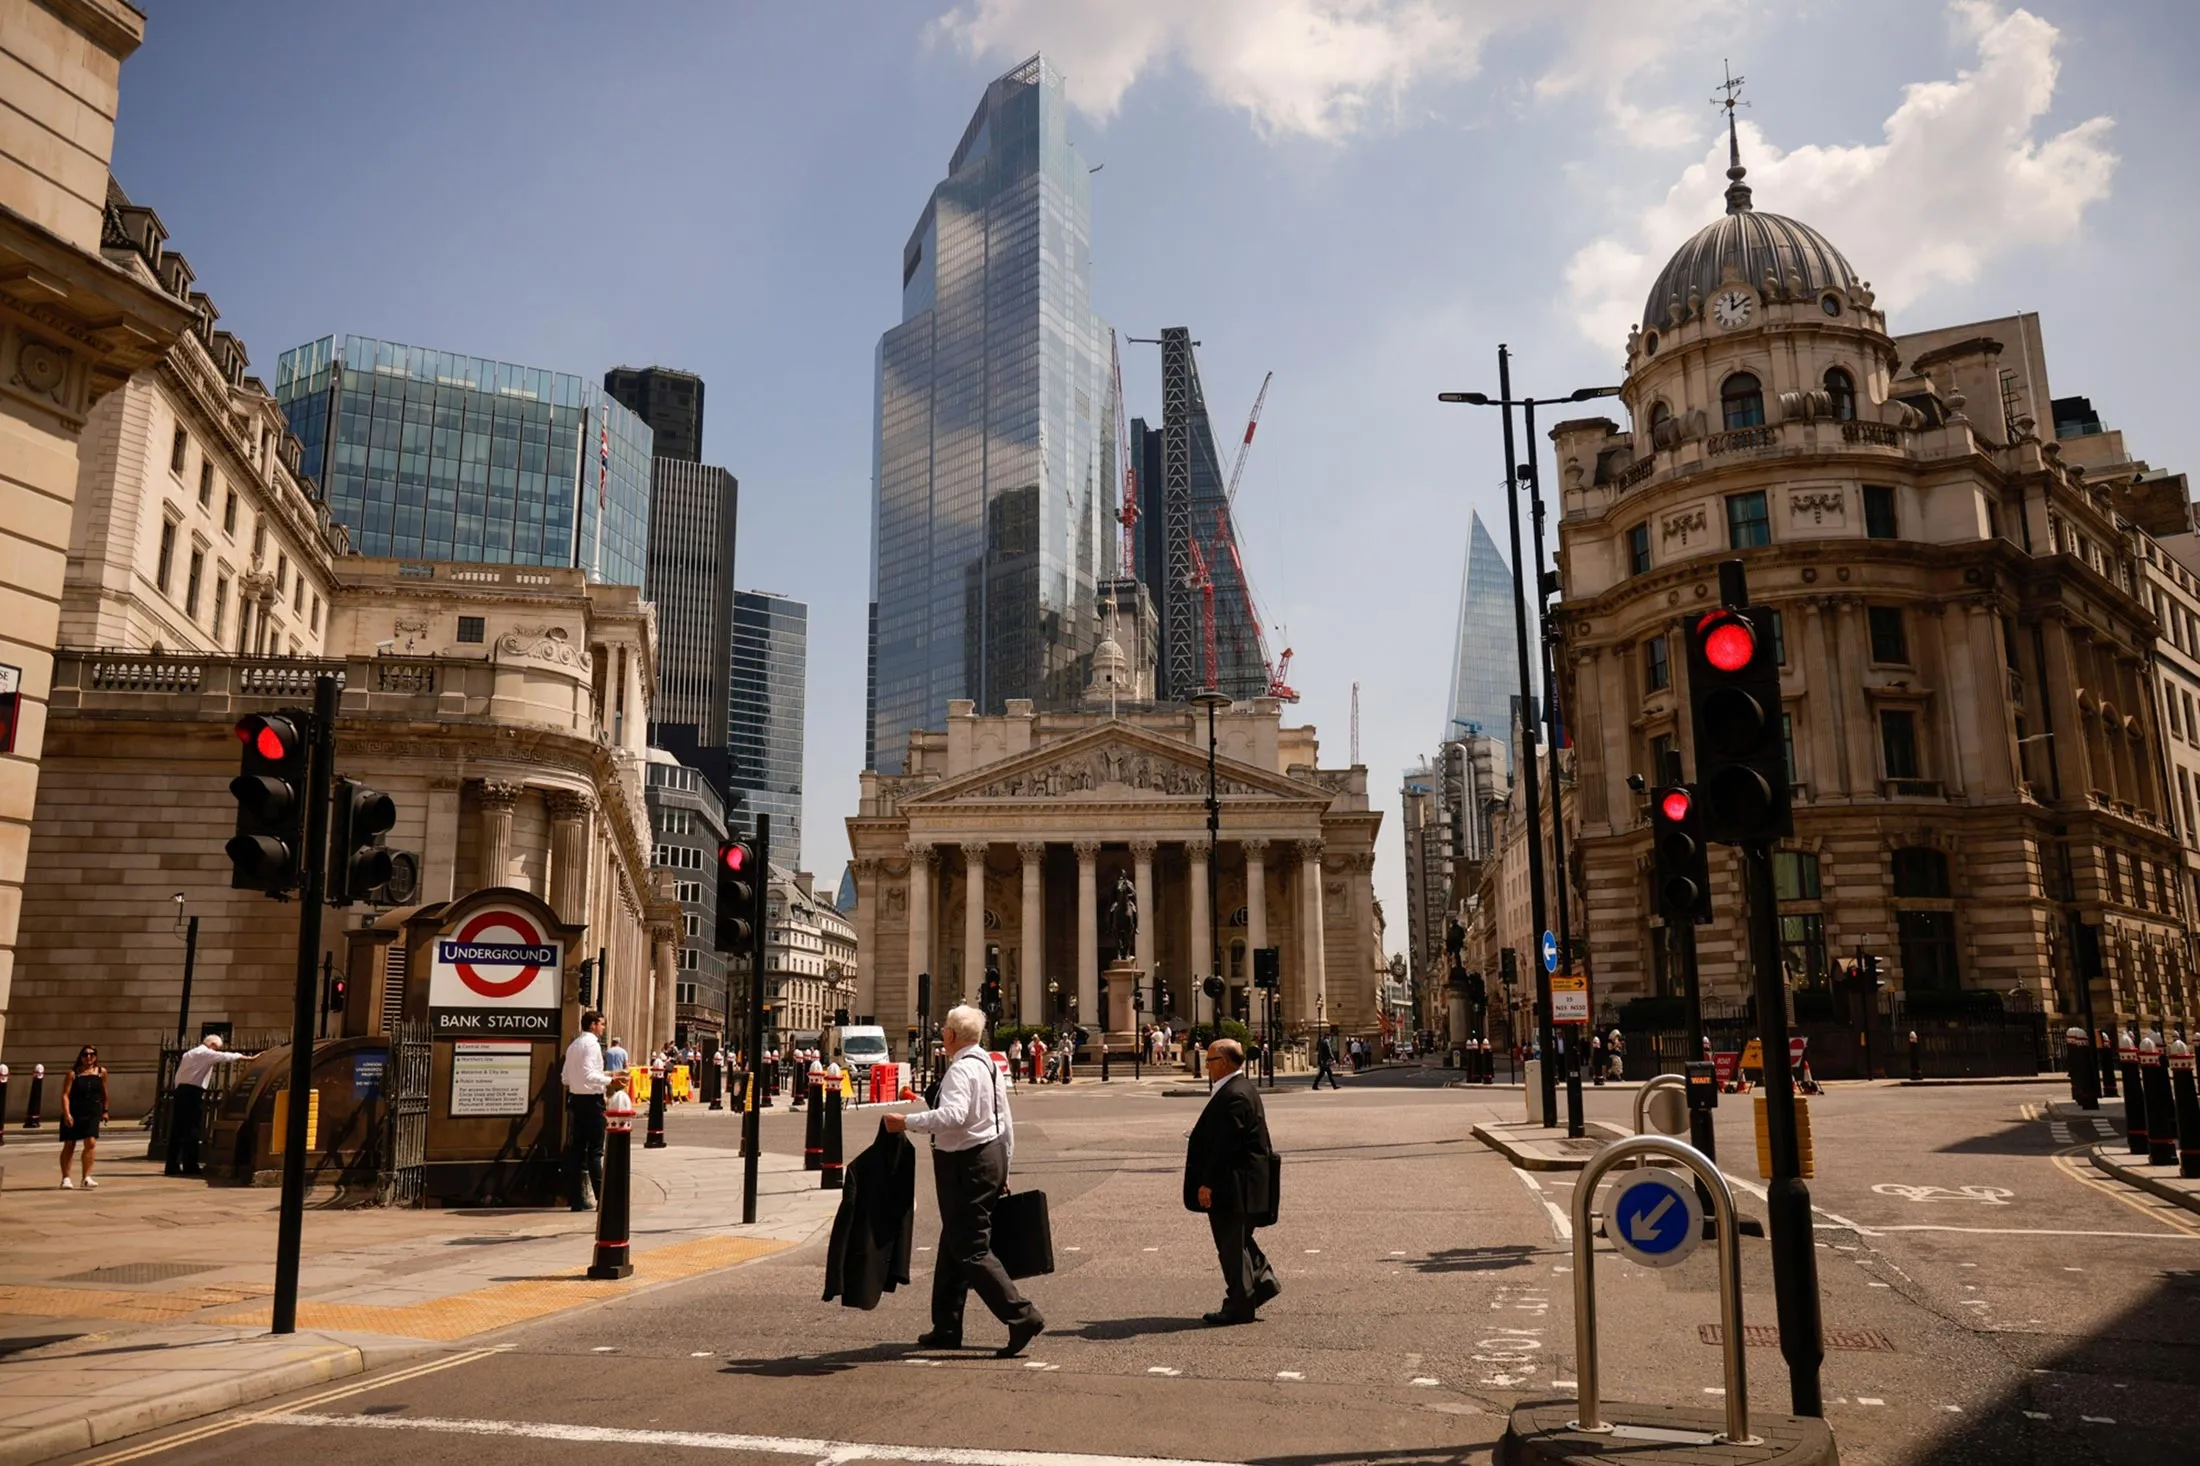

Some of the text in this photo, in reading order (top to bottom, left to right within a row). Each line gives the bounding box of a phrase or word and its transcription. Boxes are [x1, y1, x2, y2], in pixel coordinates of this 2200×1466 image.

[445, 945, 551, 962] UNDERGROUND
[440, 1015, 549, 1028] BANK STATION
